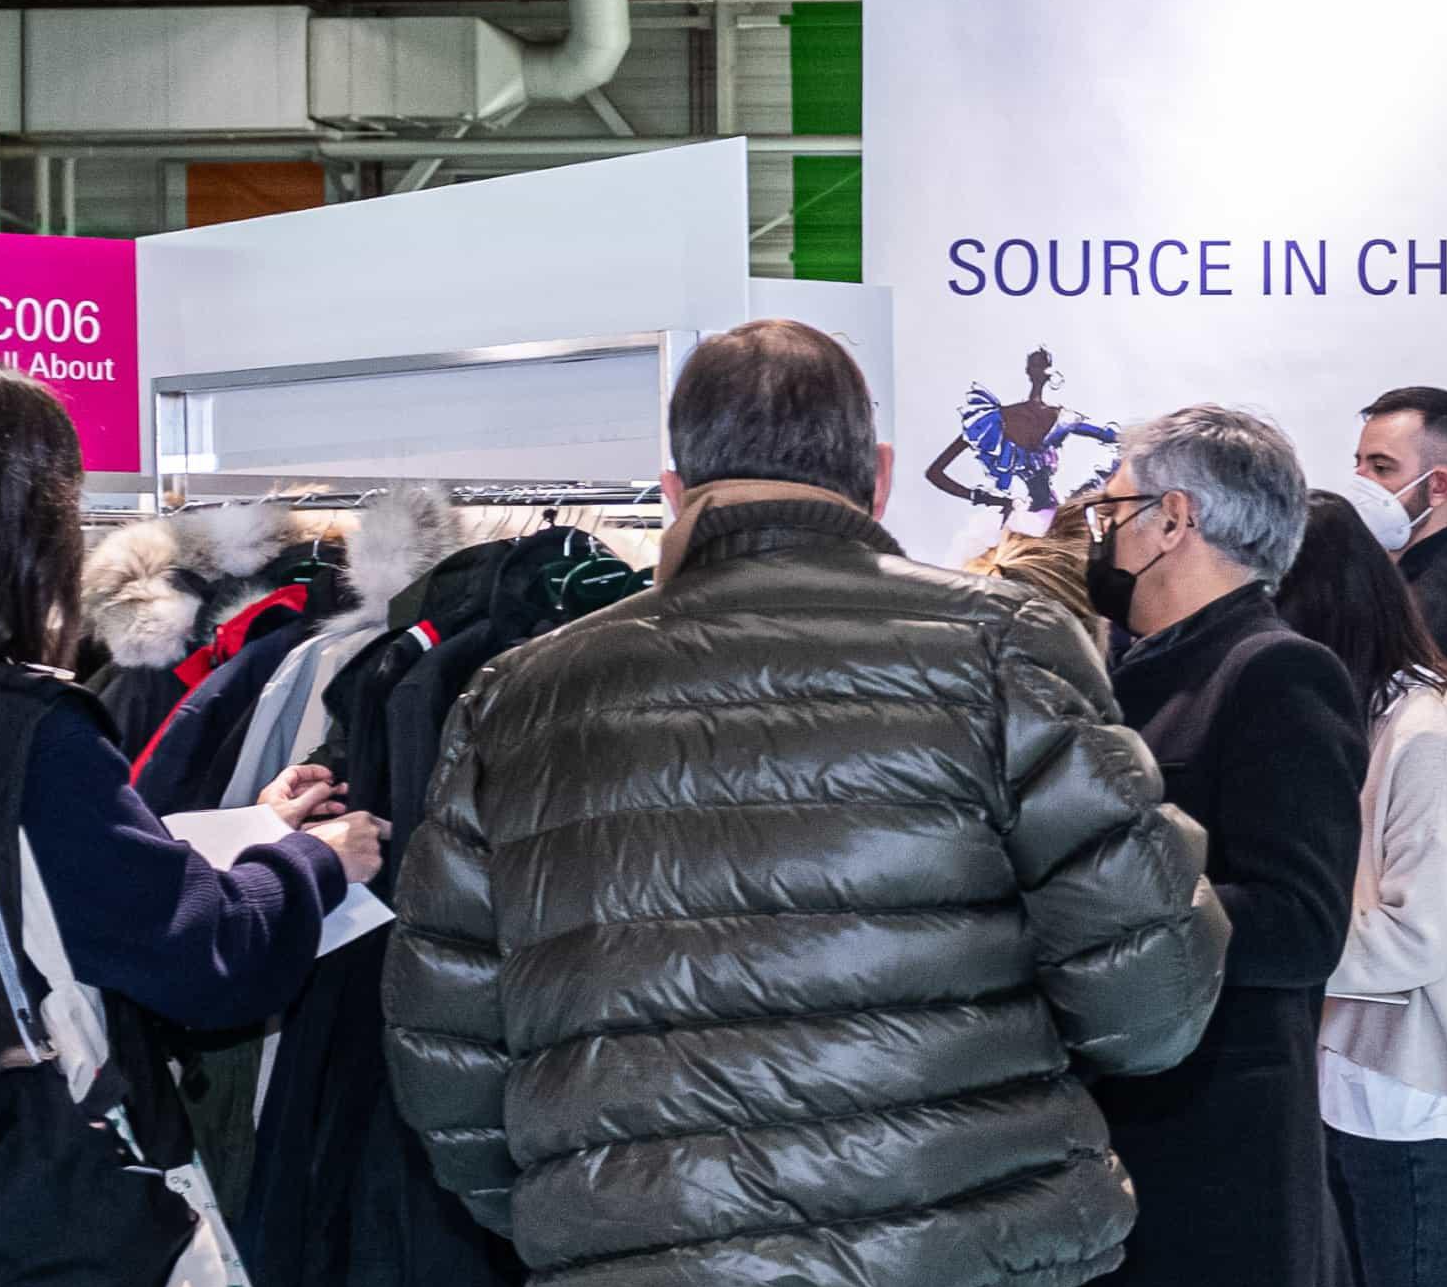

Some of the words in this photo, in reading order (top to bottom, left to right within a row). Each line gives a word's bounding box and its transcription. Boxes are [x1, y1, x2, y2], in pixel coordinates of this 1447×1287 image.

[947, 237, 1234, 298] SOURCE
[1262, 238, 1327, 296] IN
[29, 351, 116, 381] About
